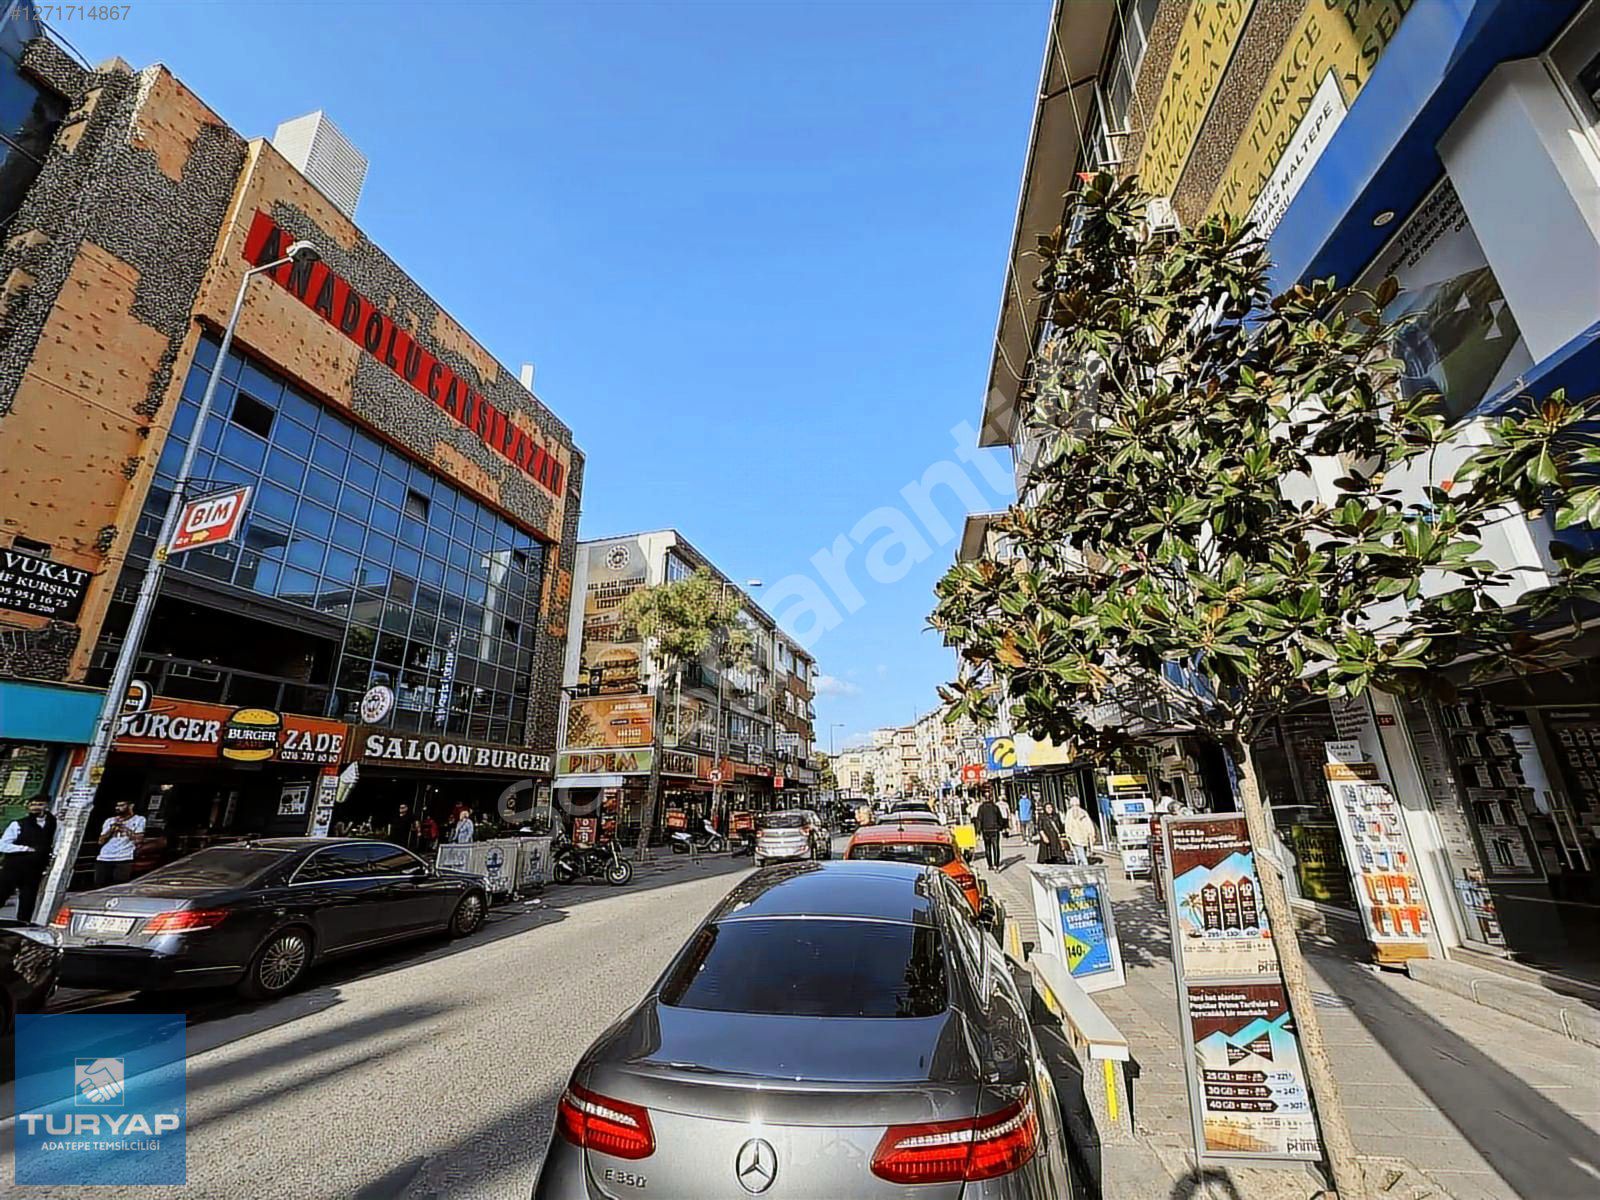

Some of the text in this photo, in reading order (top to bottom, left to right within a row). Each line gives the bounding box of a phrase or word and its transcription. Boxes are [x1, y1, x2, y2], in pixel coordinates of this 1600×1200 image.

[1249, 15, 1321, 152] TÜRKÇE
[1281, 101, 1334, 190] MALTEPE
[258, 226, 422, 381] ANADOLU
[16, 576, 79, 598] KURŞUN
[228, 728, 276, 741] BURGER
[283, 729, 343, 754] ZADE
[365, 734, 550, 772] SALOON BURGER
[605, 1169, 647, 1187] E 350
